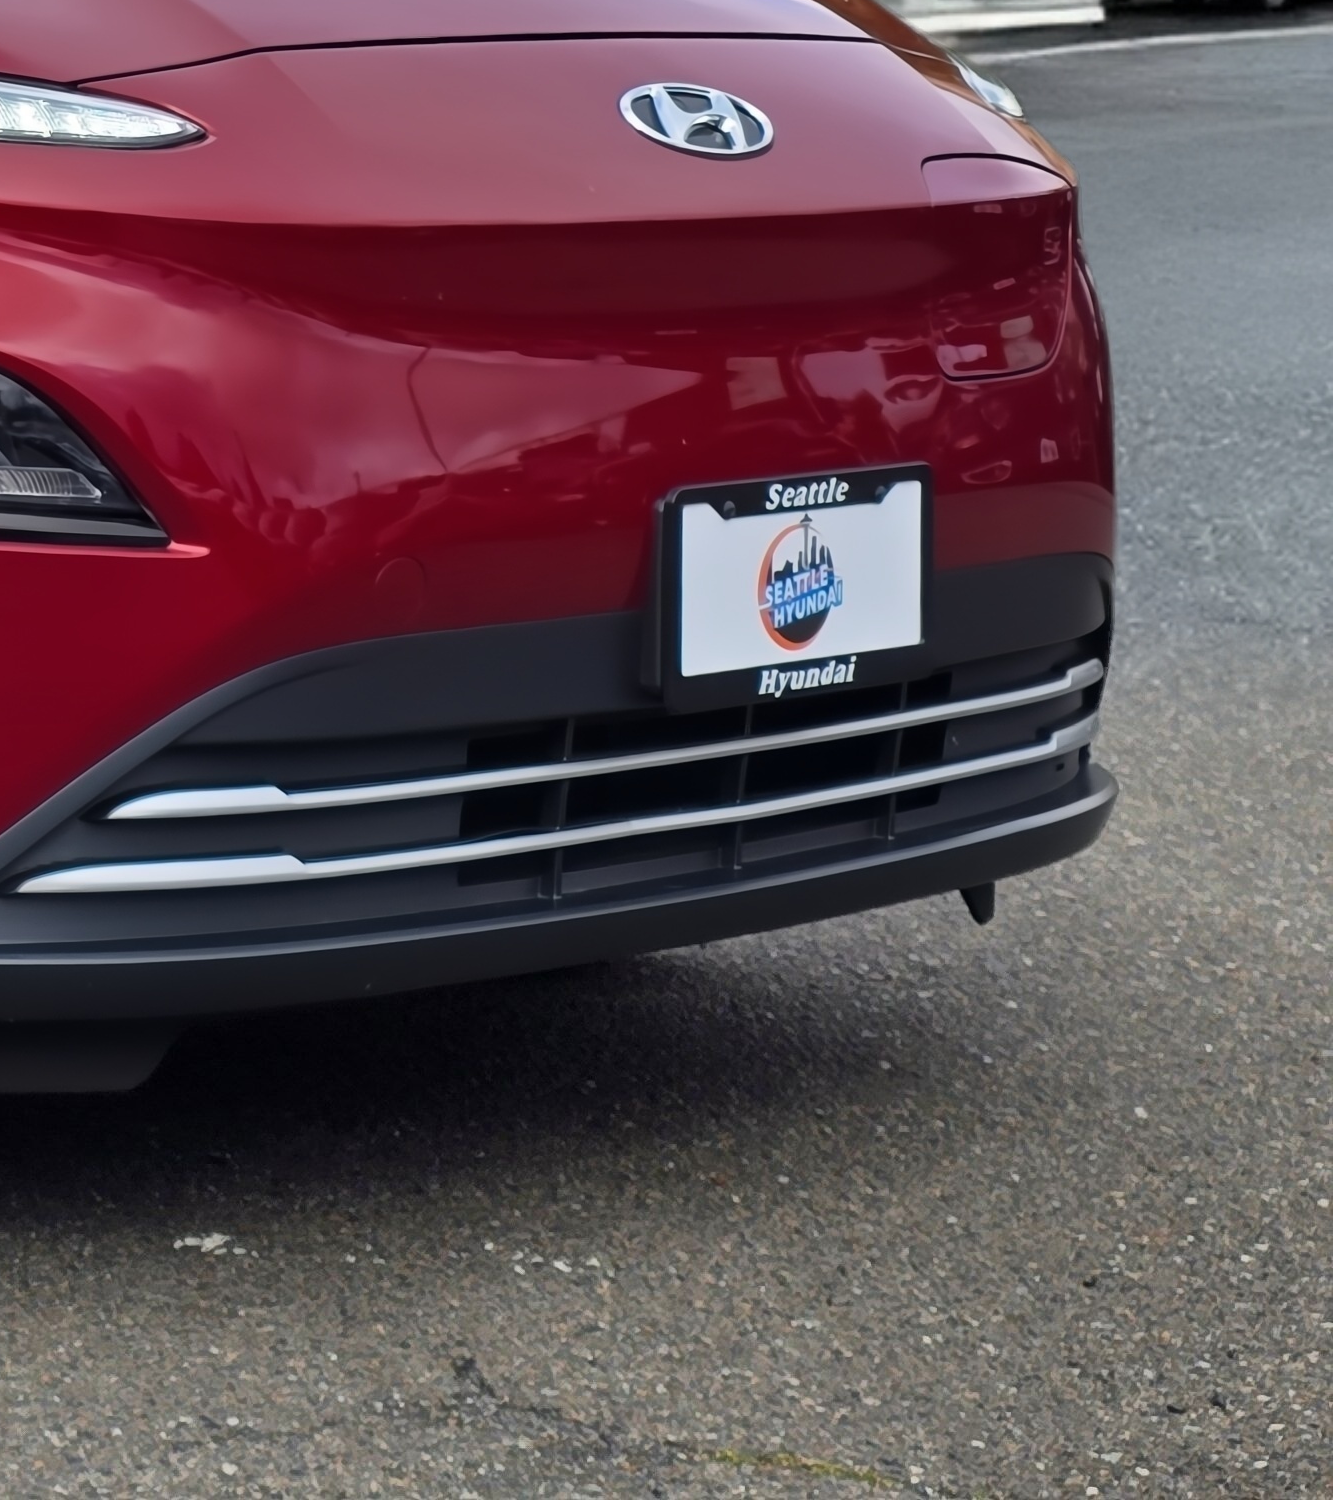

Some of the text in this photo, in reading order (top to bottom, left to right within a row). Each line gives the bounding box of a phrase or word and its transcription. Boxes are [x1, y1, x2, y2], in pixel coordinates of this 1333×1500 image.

[765, 477, 850, 511] Seattle
[765, 563, 829, 606] SEATTLE
[773, 577, 843, 629] HYUNDAI
[758, 656, 857, 698] Hyundai
